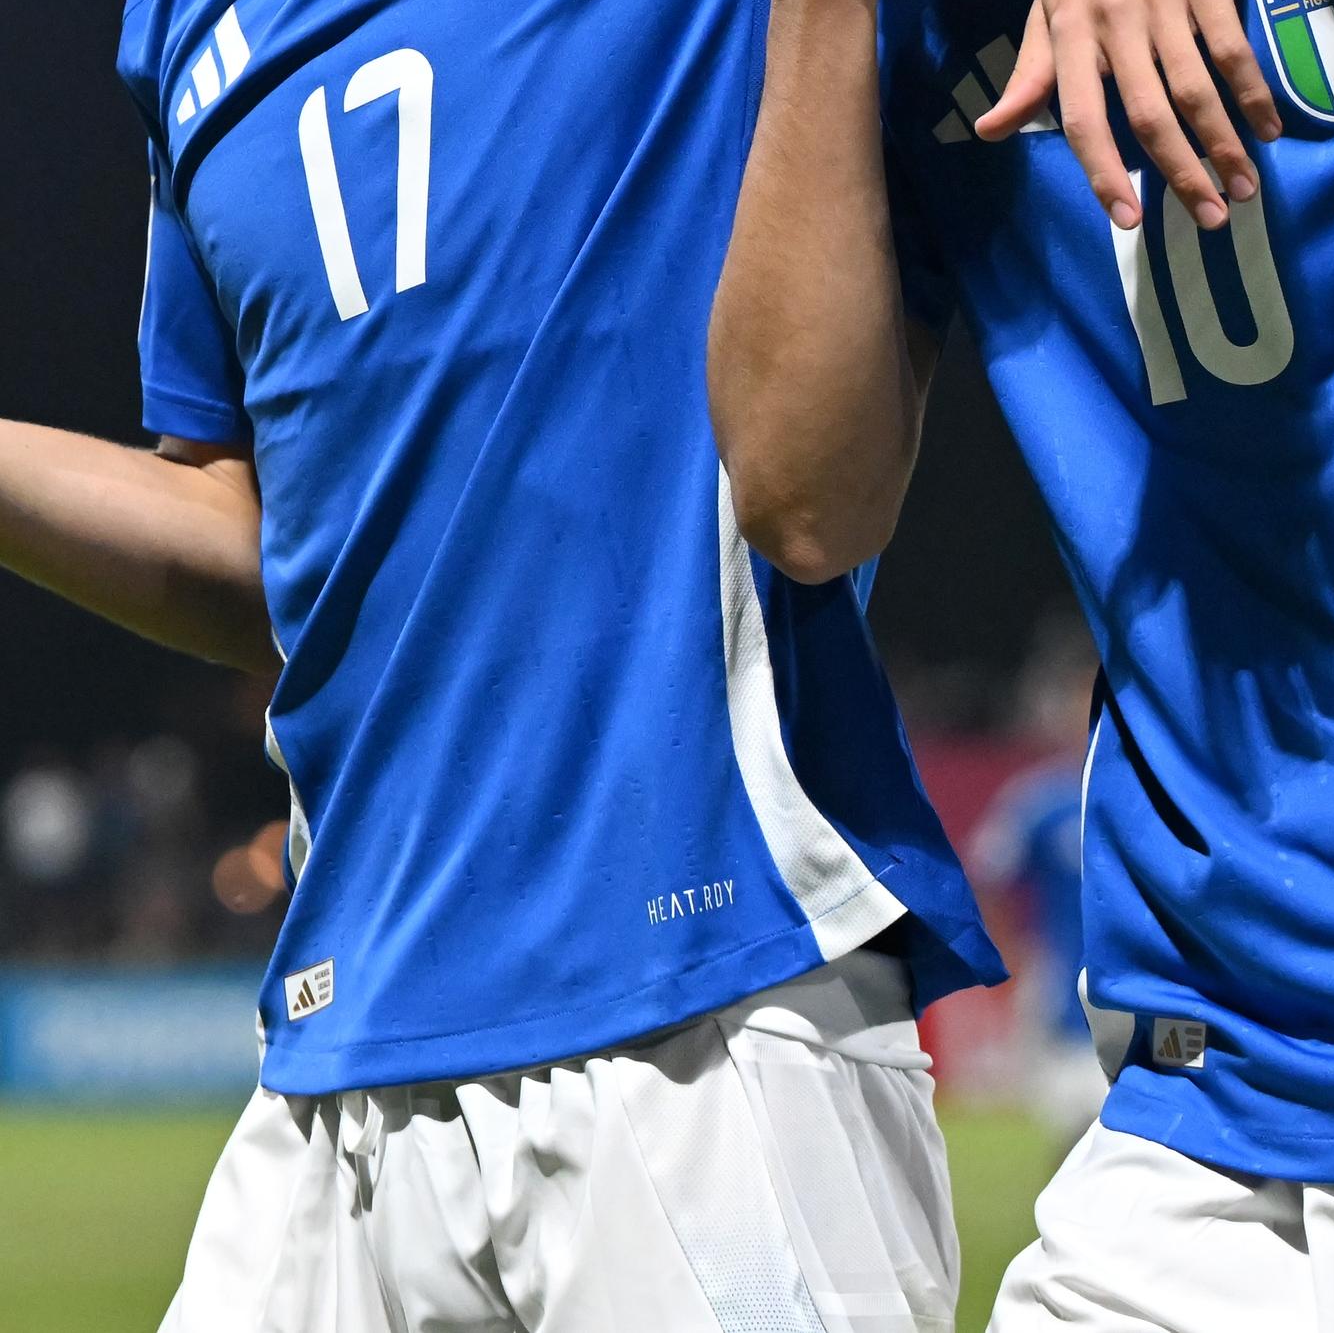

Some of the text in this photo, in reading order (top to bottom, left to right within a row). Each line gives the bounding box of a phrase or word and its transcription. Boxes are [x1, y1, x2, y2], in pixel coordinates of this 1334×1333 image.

[298, 47, 434, 322] 17
[1109, 156, 1294, 406] 10
[647, 878, 734, 926] HEAT.RDY
